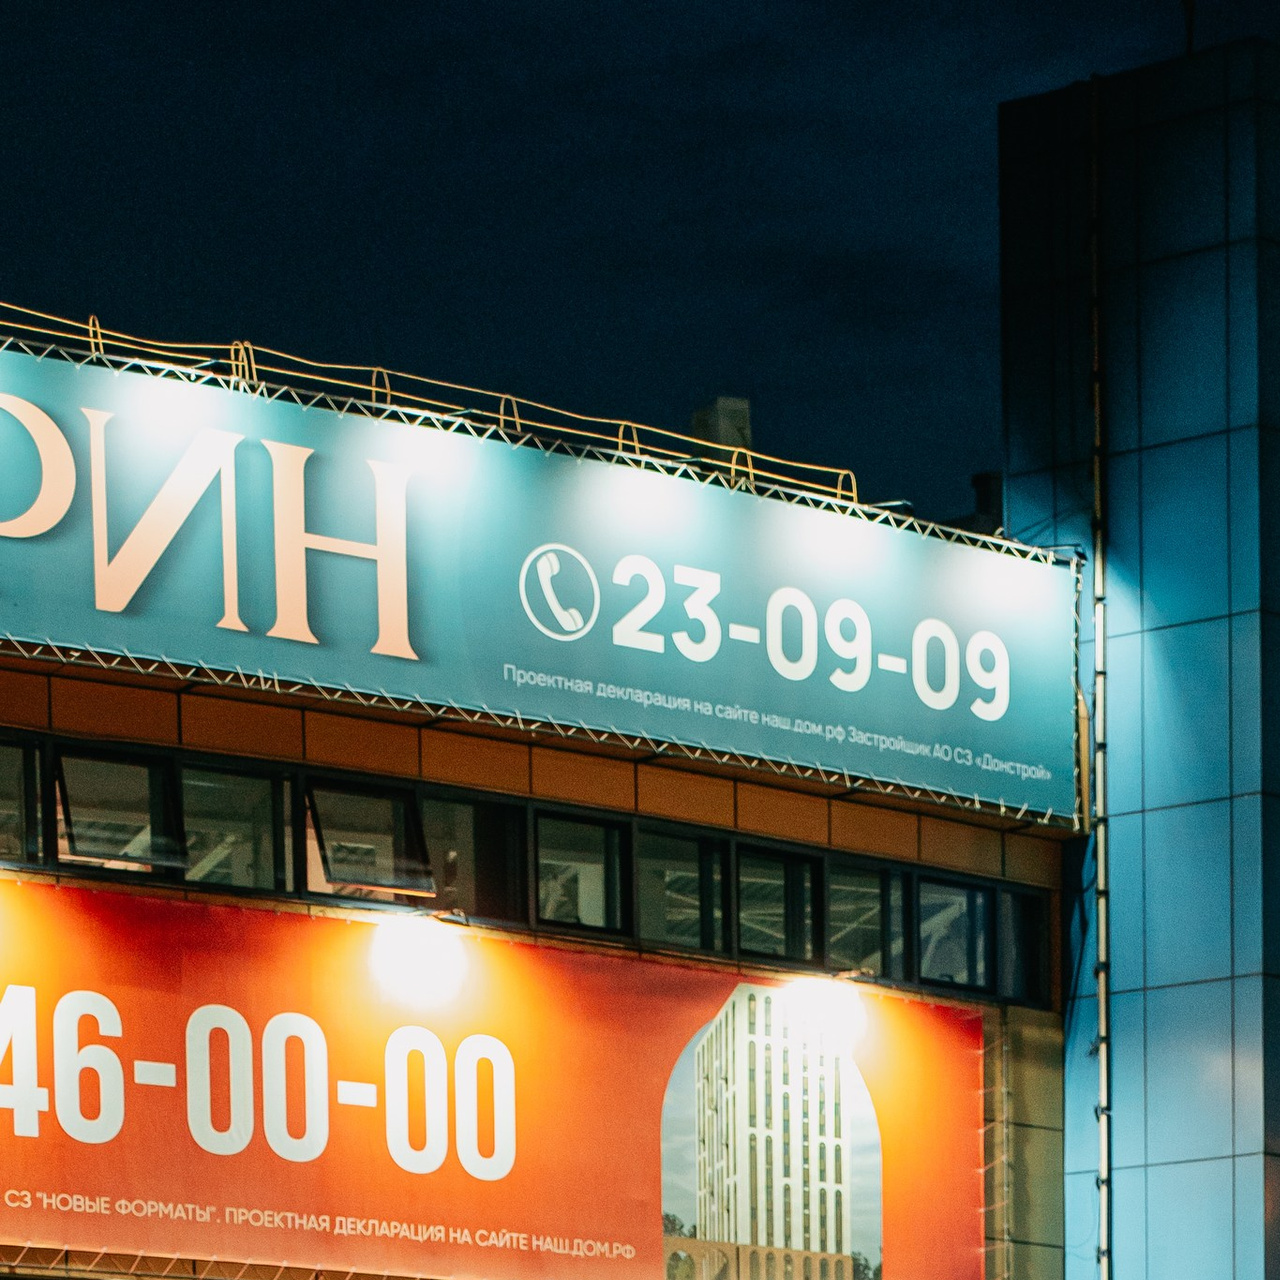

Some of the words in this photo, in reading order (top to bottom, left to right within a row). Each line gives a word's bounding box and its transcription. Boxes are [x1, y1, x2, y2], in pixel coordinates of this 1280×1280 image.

[611, 552, 1010, 723] 23-09-09
[503, 663, 593, 695] Проектная
[596, 681, 692, 709] декларация
[694, 699, 713, 716] на
[715, 703, 759, 724] сайте
[848, 725, 931, 759] Застройщик
[932, 743, 951, 762] АО
[36, 1191, 111, 1214] "НОВЫЕ
[225, 1207, 331, 1232] ПРОЕКТНАЯ
[333, 1216, 445, 1243] ДЕКЛАРАЦИЯ
[449, 1227, 472, 1244] НА
[475, 1228, 529, 1251] САЙТЕ
